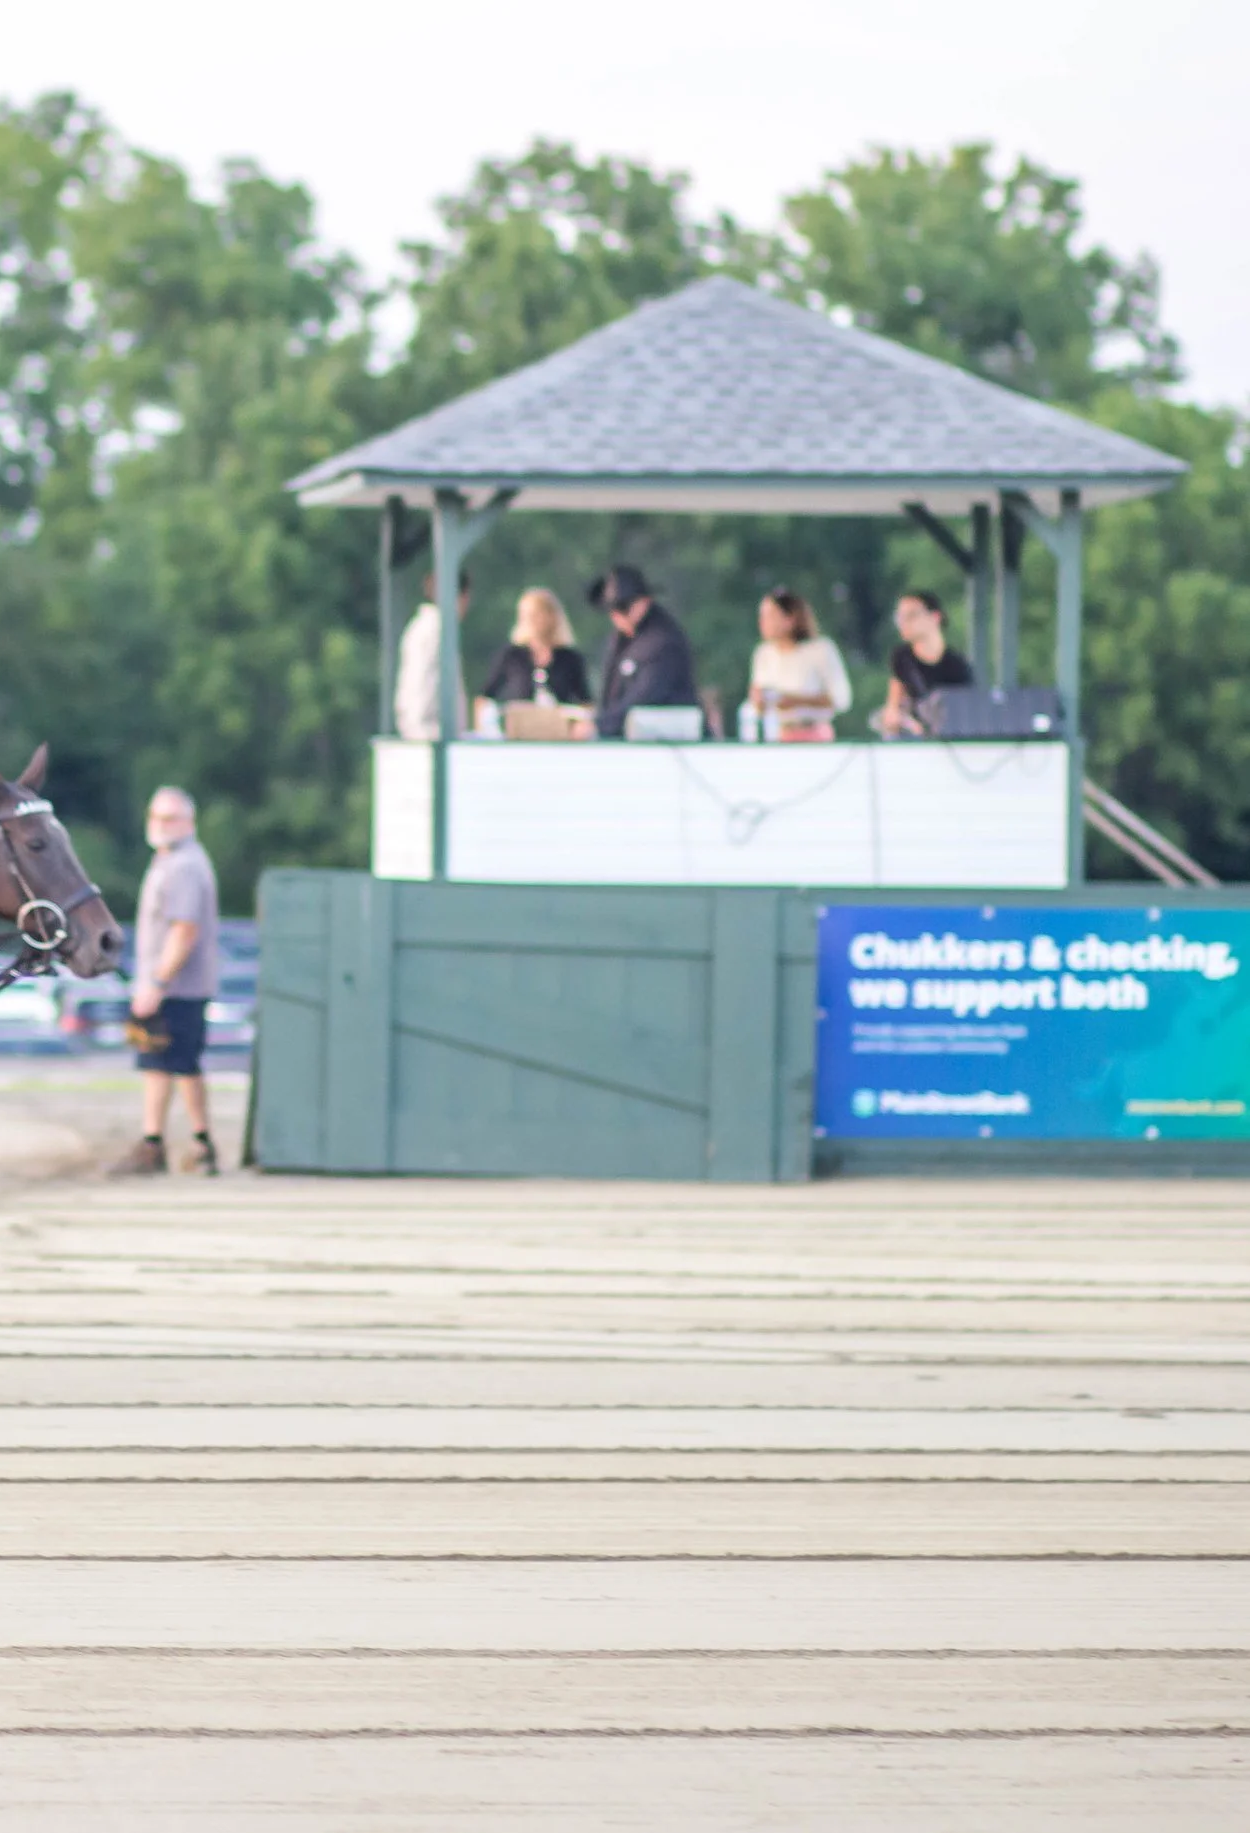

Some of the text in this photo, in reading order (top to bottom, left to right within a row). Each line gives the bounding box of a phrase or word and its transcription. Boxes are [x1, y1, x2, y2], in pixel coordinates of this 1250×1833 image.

[850, 934, 1239, 979] Chukkers & checking,
[850, 975, 1148, 1017] we support both
